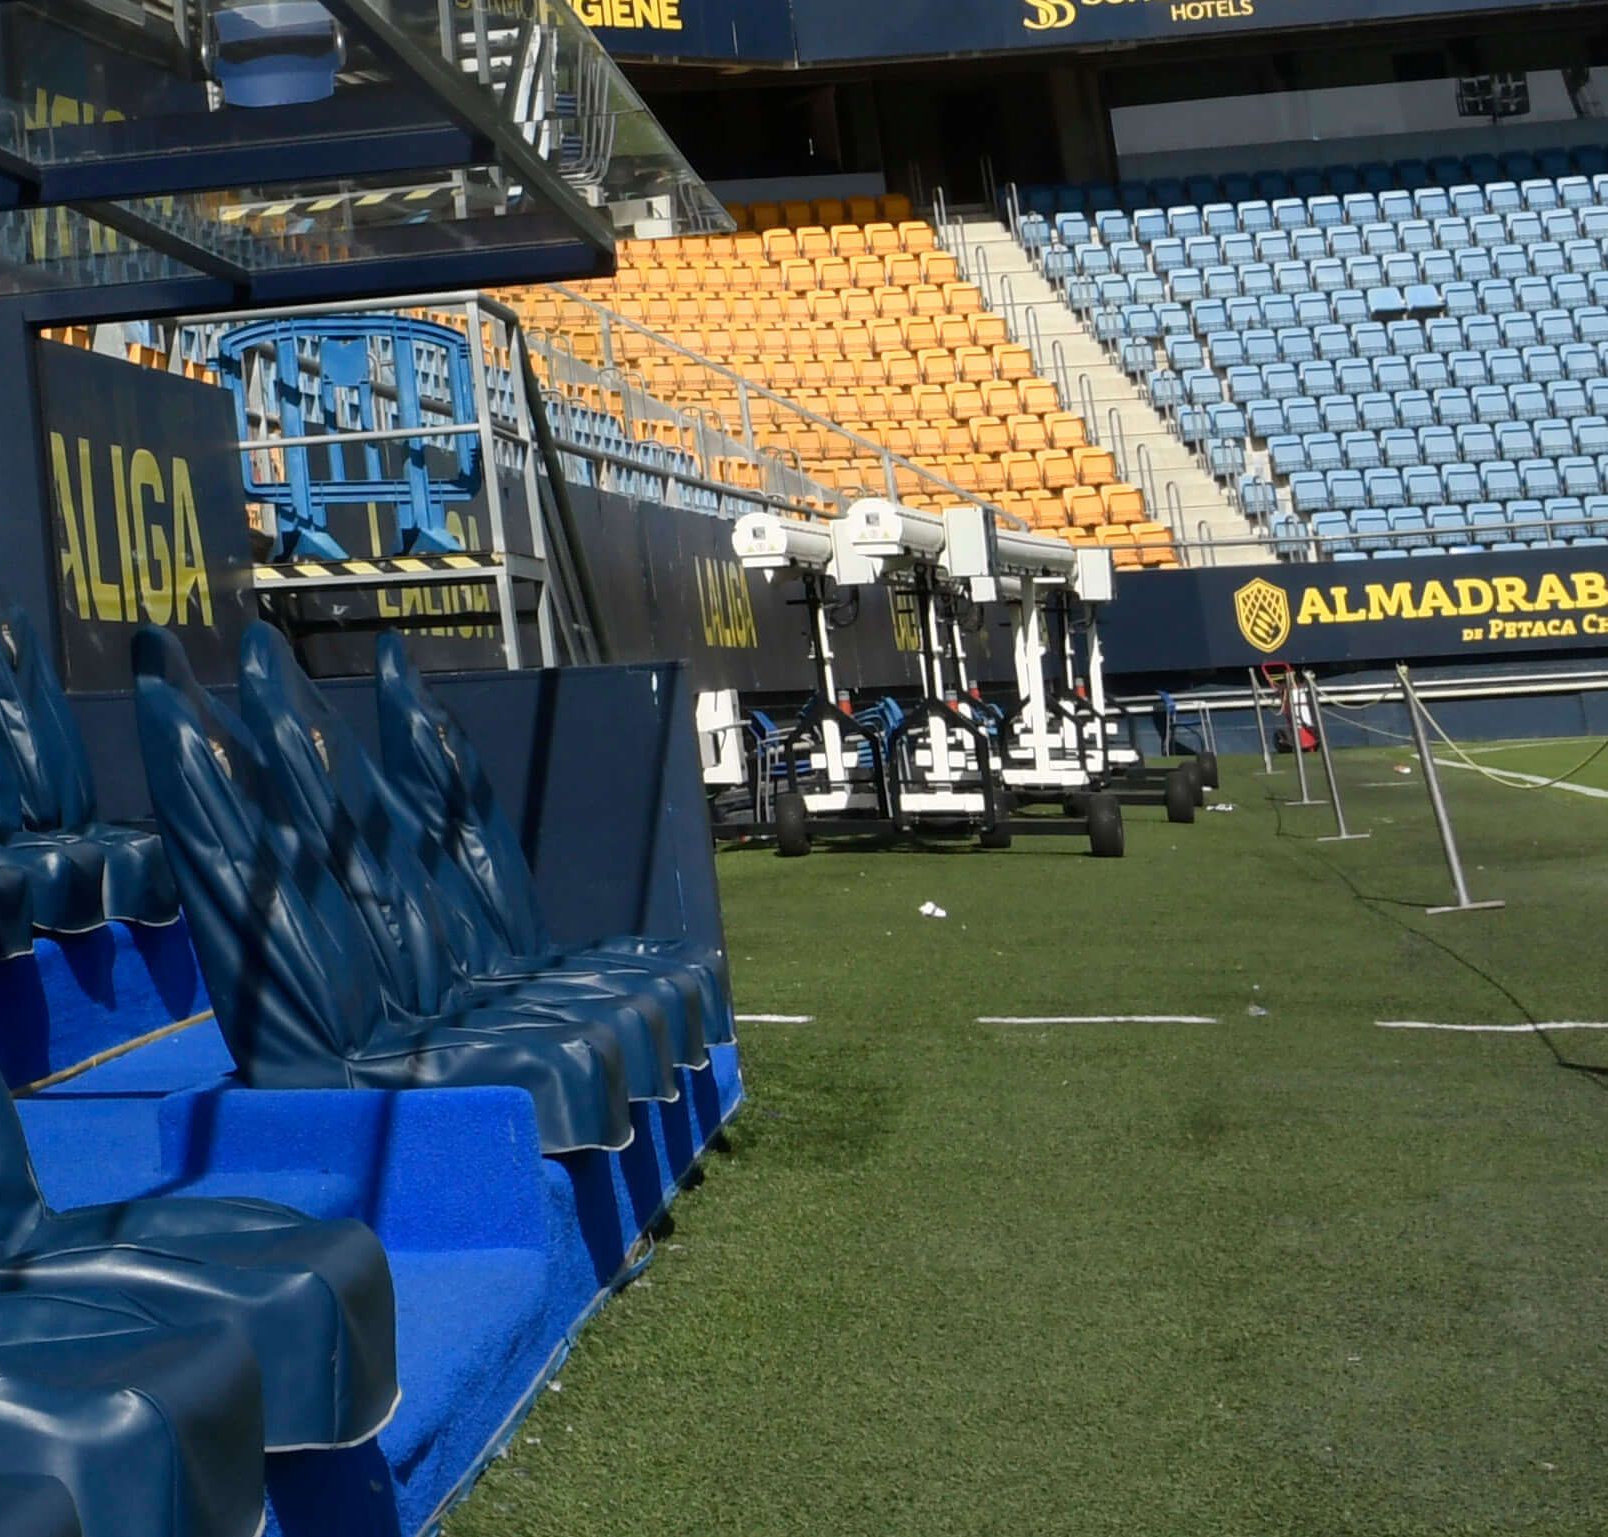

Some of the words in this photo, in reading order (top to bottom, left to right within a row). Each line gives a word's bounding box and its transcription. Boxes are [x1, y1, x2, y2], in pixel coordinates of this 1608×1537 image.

[694, 554, 759, 649] LALIGA
[1296, 571, 1608, 625] ALMADRAB
[1488, 618, 1577, 640] PETACA
